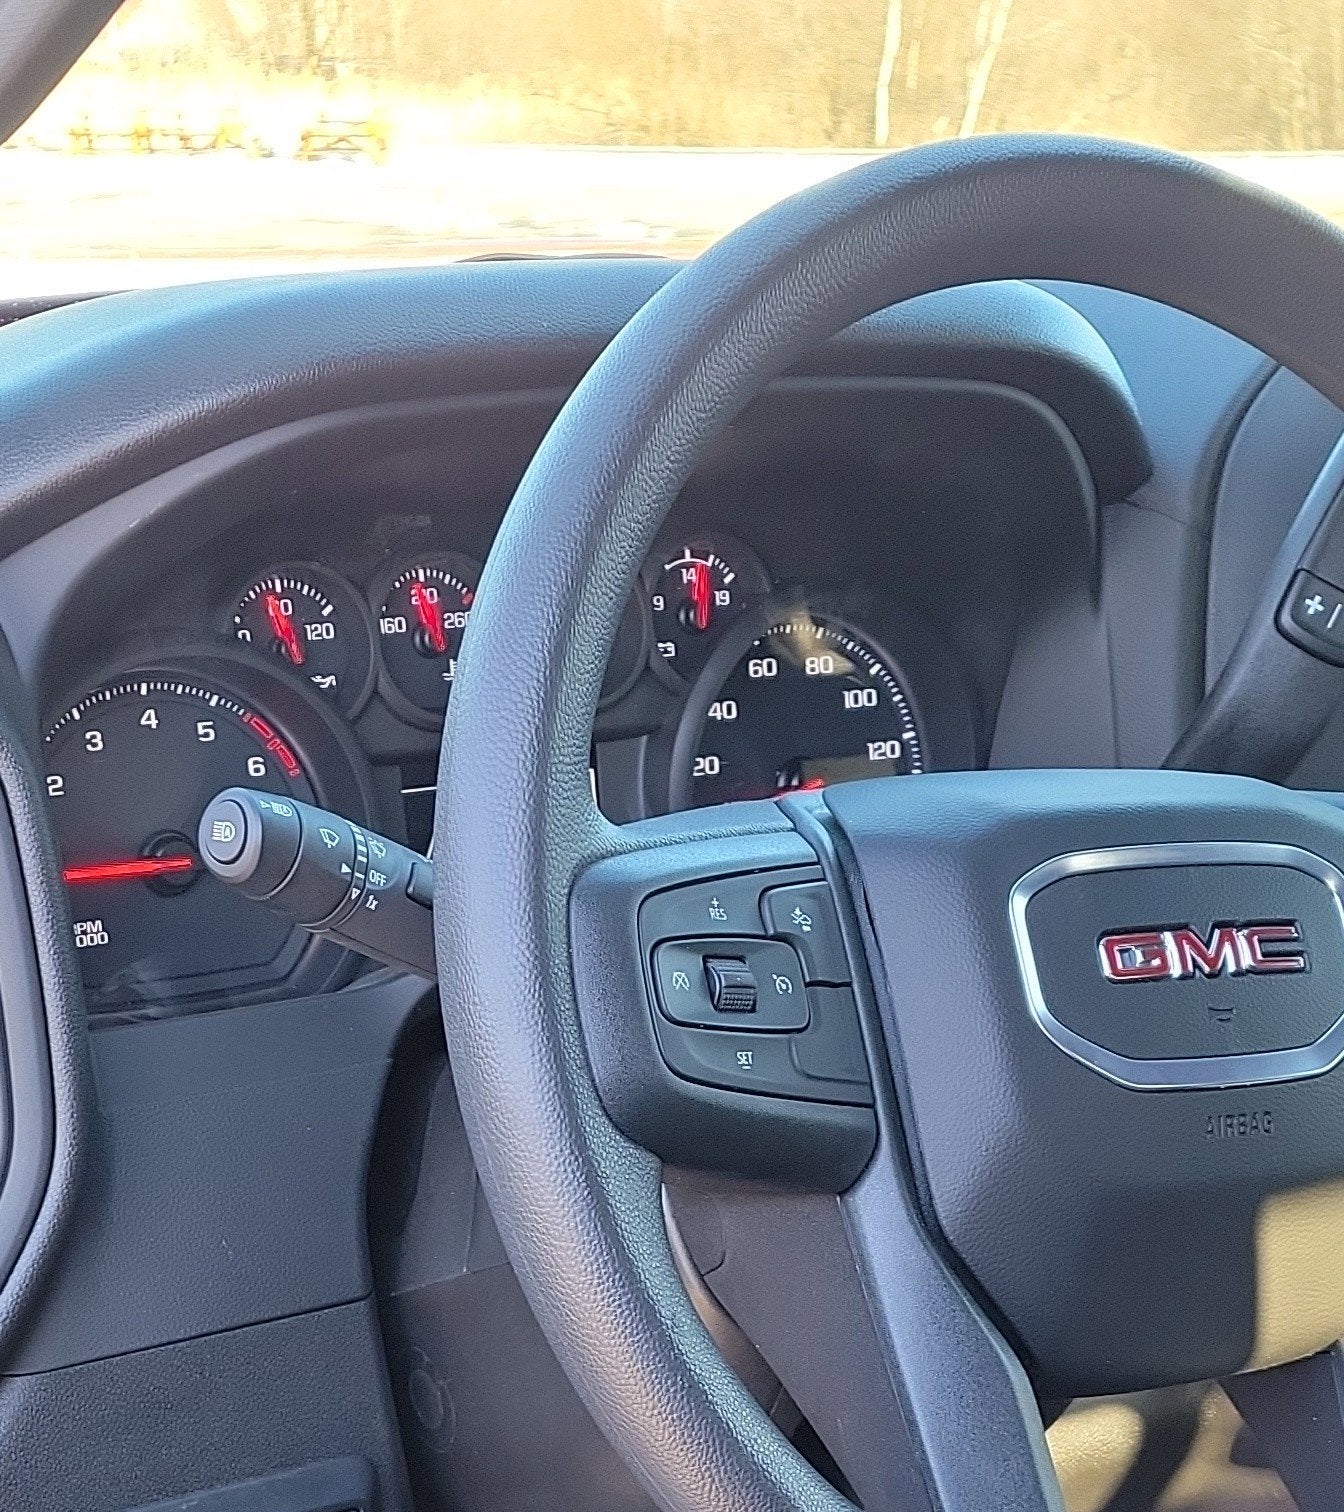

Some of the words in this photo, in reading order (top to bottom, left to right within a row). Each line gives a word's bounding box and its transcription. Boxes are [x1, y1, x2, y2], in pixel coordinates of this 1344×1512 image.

[681, 568, 697, 584] 14
[653, 595, 665, 611] 9
[714, 589, 731, 607] 19
[304, 622, 335, 641] 120
[379, 616, 406, 635] 160
[748, 657, 778, 678] 60
[805, 655, 834, 675] 80
[842, 688, 878, 709] 100
[140, 708, 159, 730] 4
[707, 700, 738, 721] 40
[84, 730, 104, 752] 3
[197, 721, 216, 742] 5
[867, 740, 902, 761] 120
[247, 757, 266, 777] 6
[692, 756, 720, 777] 20
[46, 775, 65, 797] 2
[369, 869, 387, 887] OFF
[366, 894, 379, 911] 1x
[709, 907, 728, 921] RES
[1098, 925, 1306, 982] GMC
[736, 1051, 753, 1065] SET
[1206, 1110, 1275, 1139] AIRBAG
